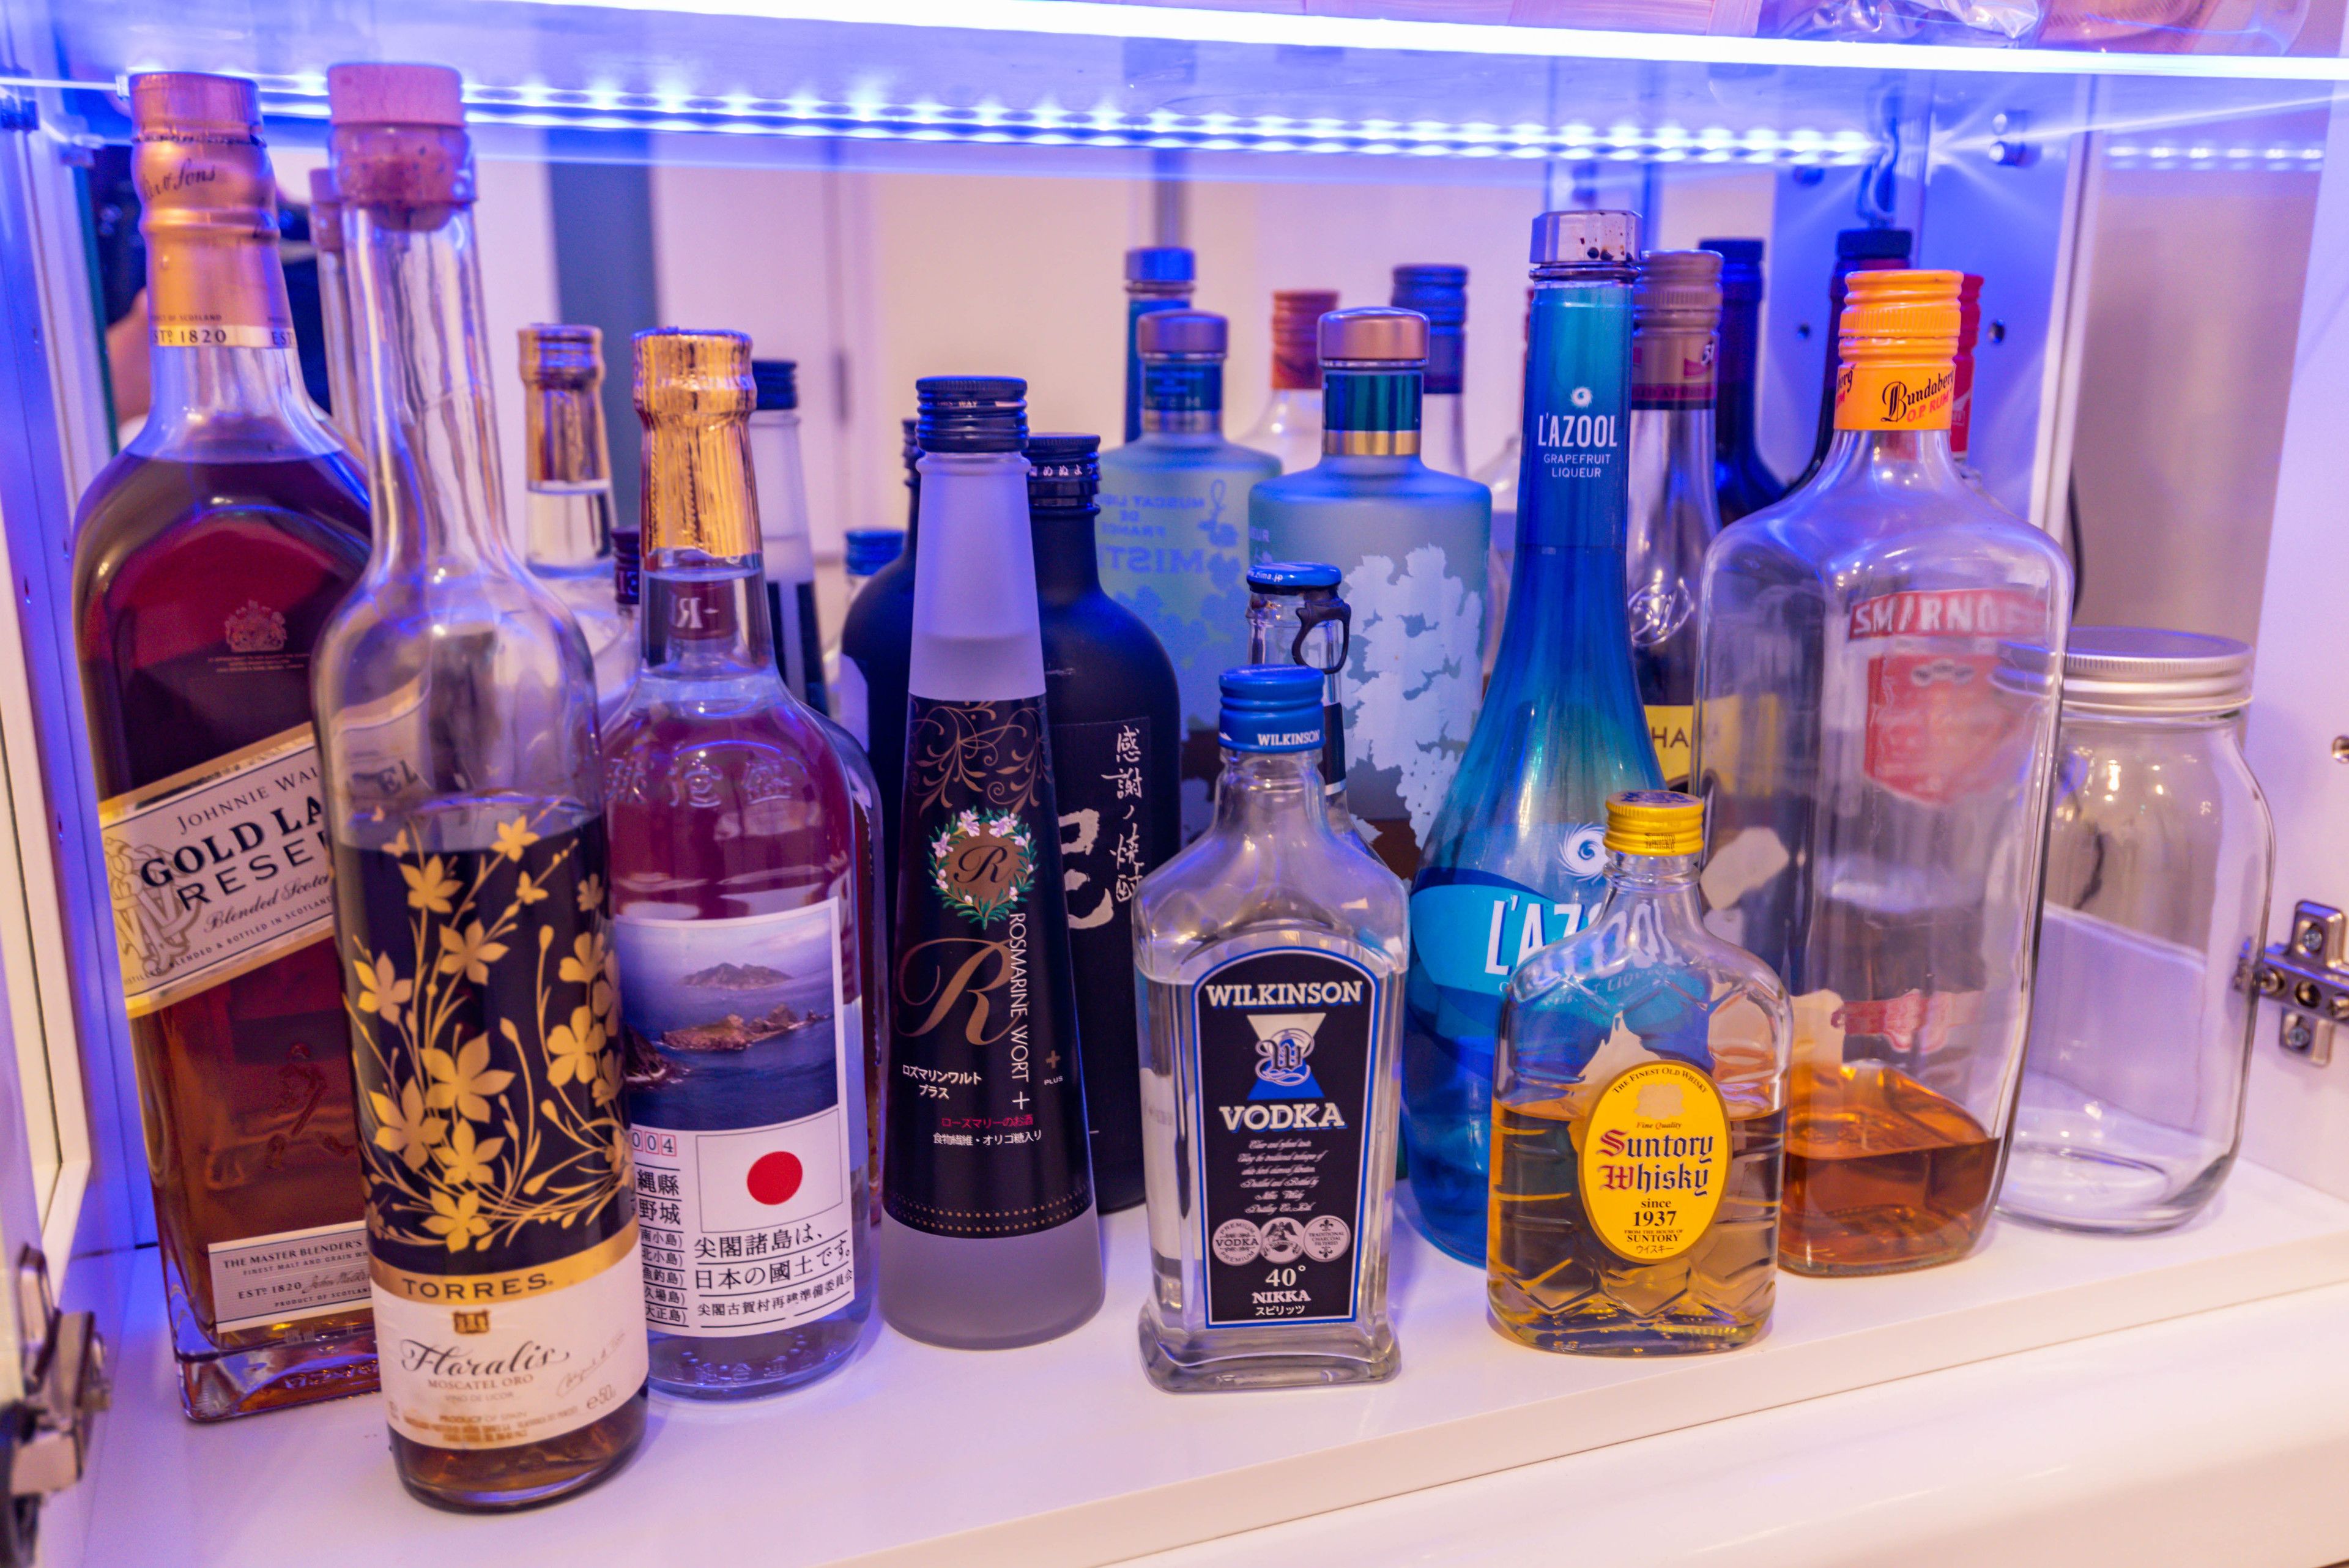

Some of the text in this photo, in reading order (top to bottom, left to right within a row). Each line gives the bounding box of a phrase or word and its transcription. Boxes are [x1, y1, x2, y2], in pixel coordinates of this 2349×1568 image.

[180, 329, 227, 343] 1820
[1538, 412, 1618, 448] L'AZOOL
[1543, 453, 1611, 464] GRAPEFRUIT
[1551, 467, 1601, 478] LIQUEUR
[1257, 729, 1320, 746] WILKINSON
[176, 786, 270, 836] JOHNNIE
[140, 821, 265, 887] GOLD
[953, 845, 1012, 885] R
[203, 890, 280, 934] Blended
[169, 947, 212, 968] BLENDED
[226, 923, 269, 945] BOTTLED
[272, 916, 282, 927] IN
[1009, 912, 1028, 1017] ROSMARINE
[895, 937, 1029, 1045] R
[1206, 981, 1364, 1008] WILKINSON
[1011, 1025, 1029, 1082] WORT
[902, 1065, 982, 1085] ロズマリンワルト
[1044, 1076, 1064, 1085] PLUS
[1612, 1067, 1709, 1094] THE FINEST OLD WHISKY
[919, 1084, 949, 1099] プラス
[941, 1113, 1033, 1129] ローズマリーのお酒
[1219, 1102, 1346, 1131] VODKA
[1595, 1129, 1713, 1164] Suntory
[1597, 1162, 1709, 1197] Whisky
[639, 1198, 681, 1225] 野城
[1641, 1198, 1672, 1208] since
[1220, 1222, 1255, 1235] PREMIUM
[1633, 1210, 1677, 1227] 1937
[694, 1223, 823, 1258] 尖閣諸島は、
[1627, 1234, 1679, 1243] SUNTORY
[1636, 1244, 1674, 1254] ウイスキー
[224, 1239, 363, 1269] THE MASTER BLENDER'S
[243, 1266, 274, 1276] FINEST
[325, 1254, 352, 1263] GRAIN
[696, 1239, 851, 1290] 日本の國土です。
[1221, 1250, 1255, 1263] PREMIUM
[272, 1282, 302, 1294] 1820
[403, 1273, 549, 1300] TORRES
[1252, 1290, 1312, 1304] NIKKA
[275, 1296, 314, 1307] PRODUCT
[400, 1340, 570, 1377] Floralis
[428, 1374, 534, 1391] MOSCATEL ORO
